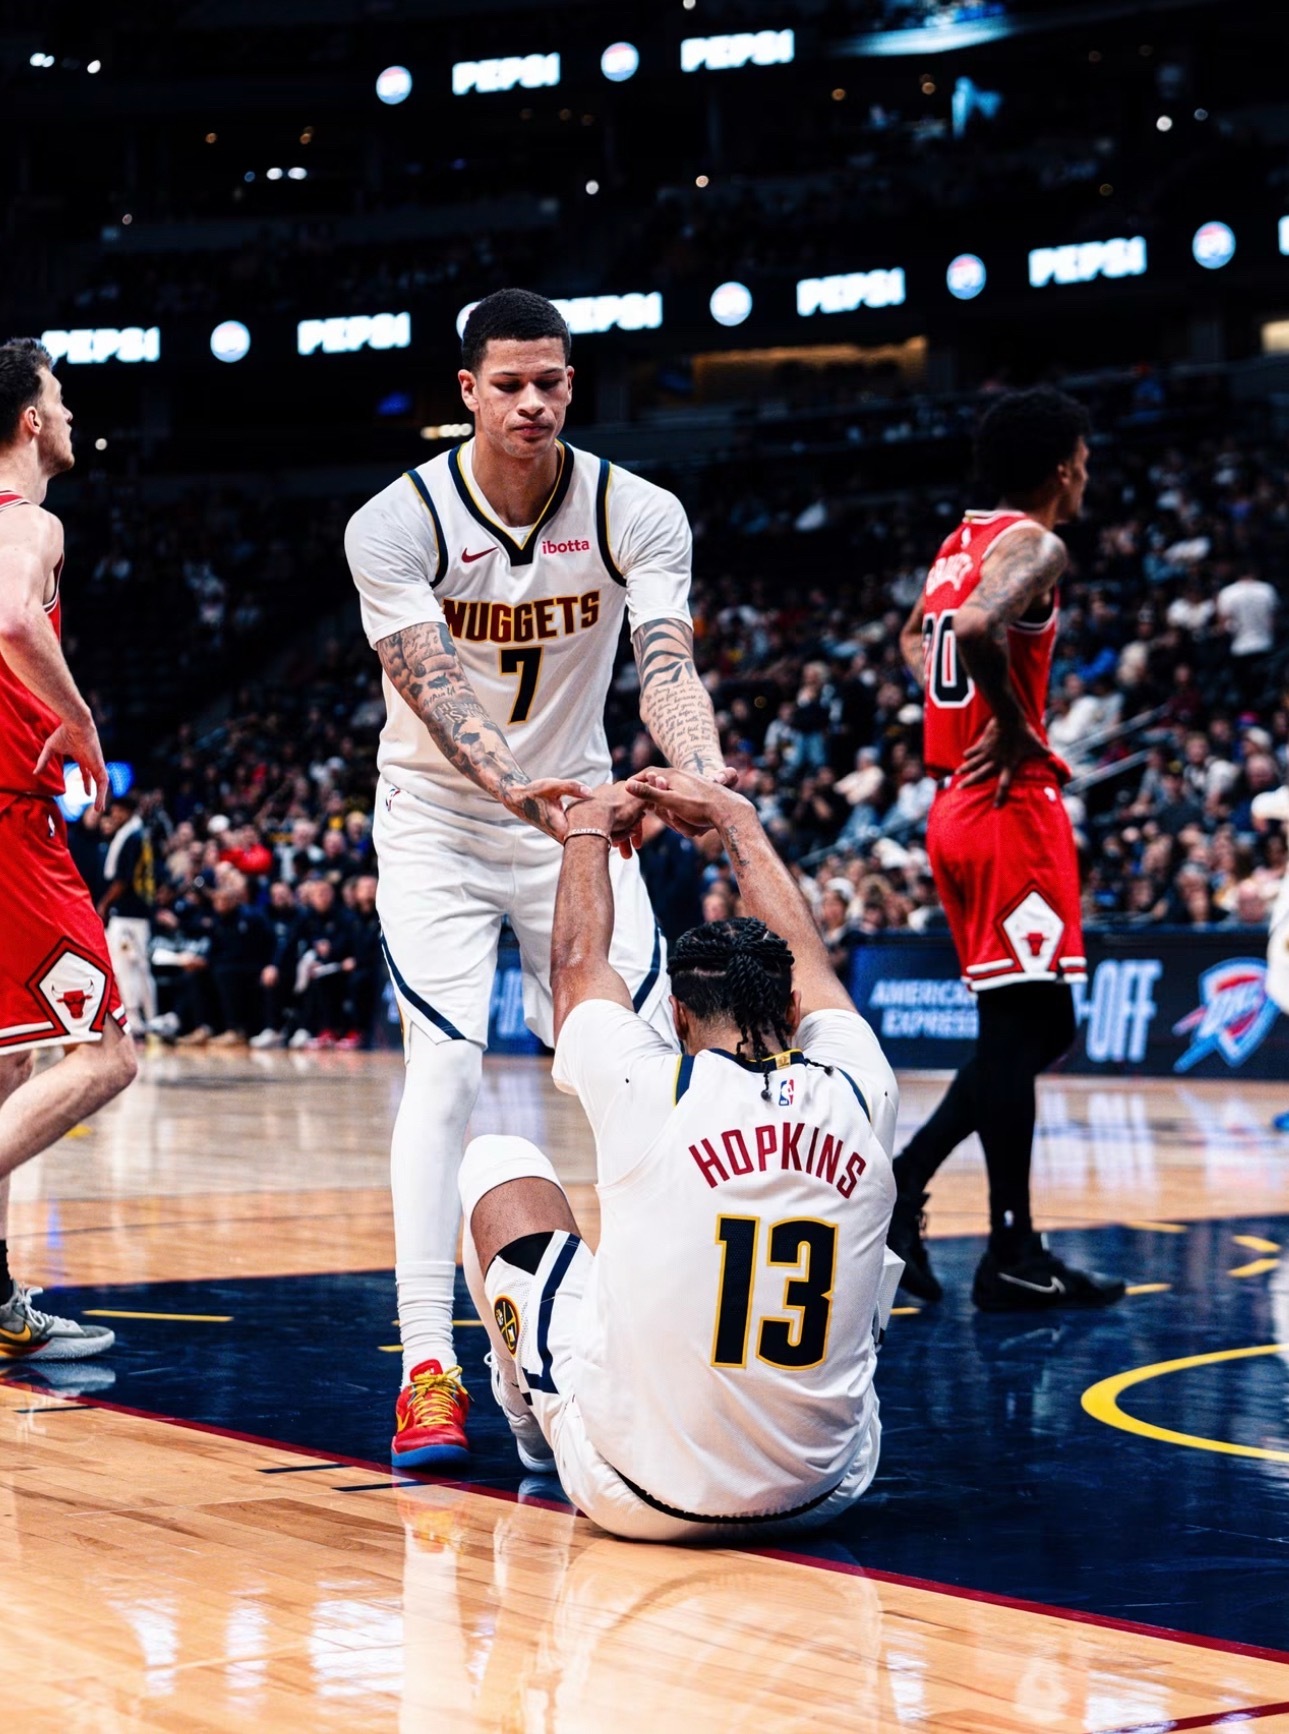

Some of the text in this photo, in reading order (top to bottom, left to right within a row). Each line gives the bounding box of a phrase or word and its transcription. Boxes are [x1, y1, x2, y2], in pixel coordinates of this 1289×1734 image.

[452, 52, 560, 95] PEPSI
[681, 29, 794, 72] PEPSI
[1028, 236, 1147, 287] PEPSI
[797, 267, 906, 316] PEPSI
[297, 312, 411, 355] PEPSI
[542, 540, 590, 554] ibotta
[443, 591, 600, 643] NUGGETS
[499, 645, 544, 725] 7
[689, 1121, 866, 1199] HOPKINS
[710, 1213, 839, 1371] 13
